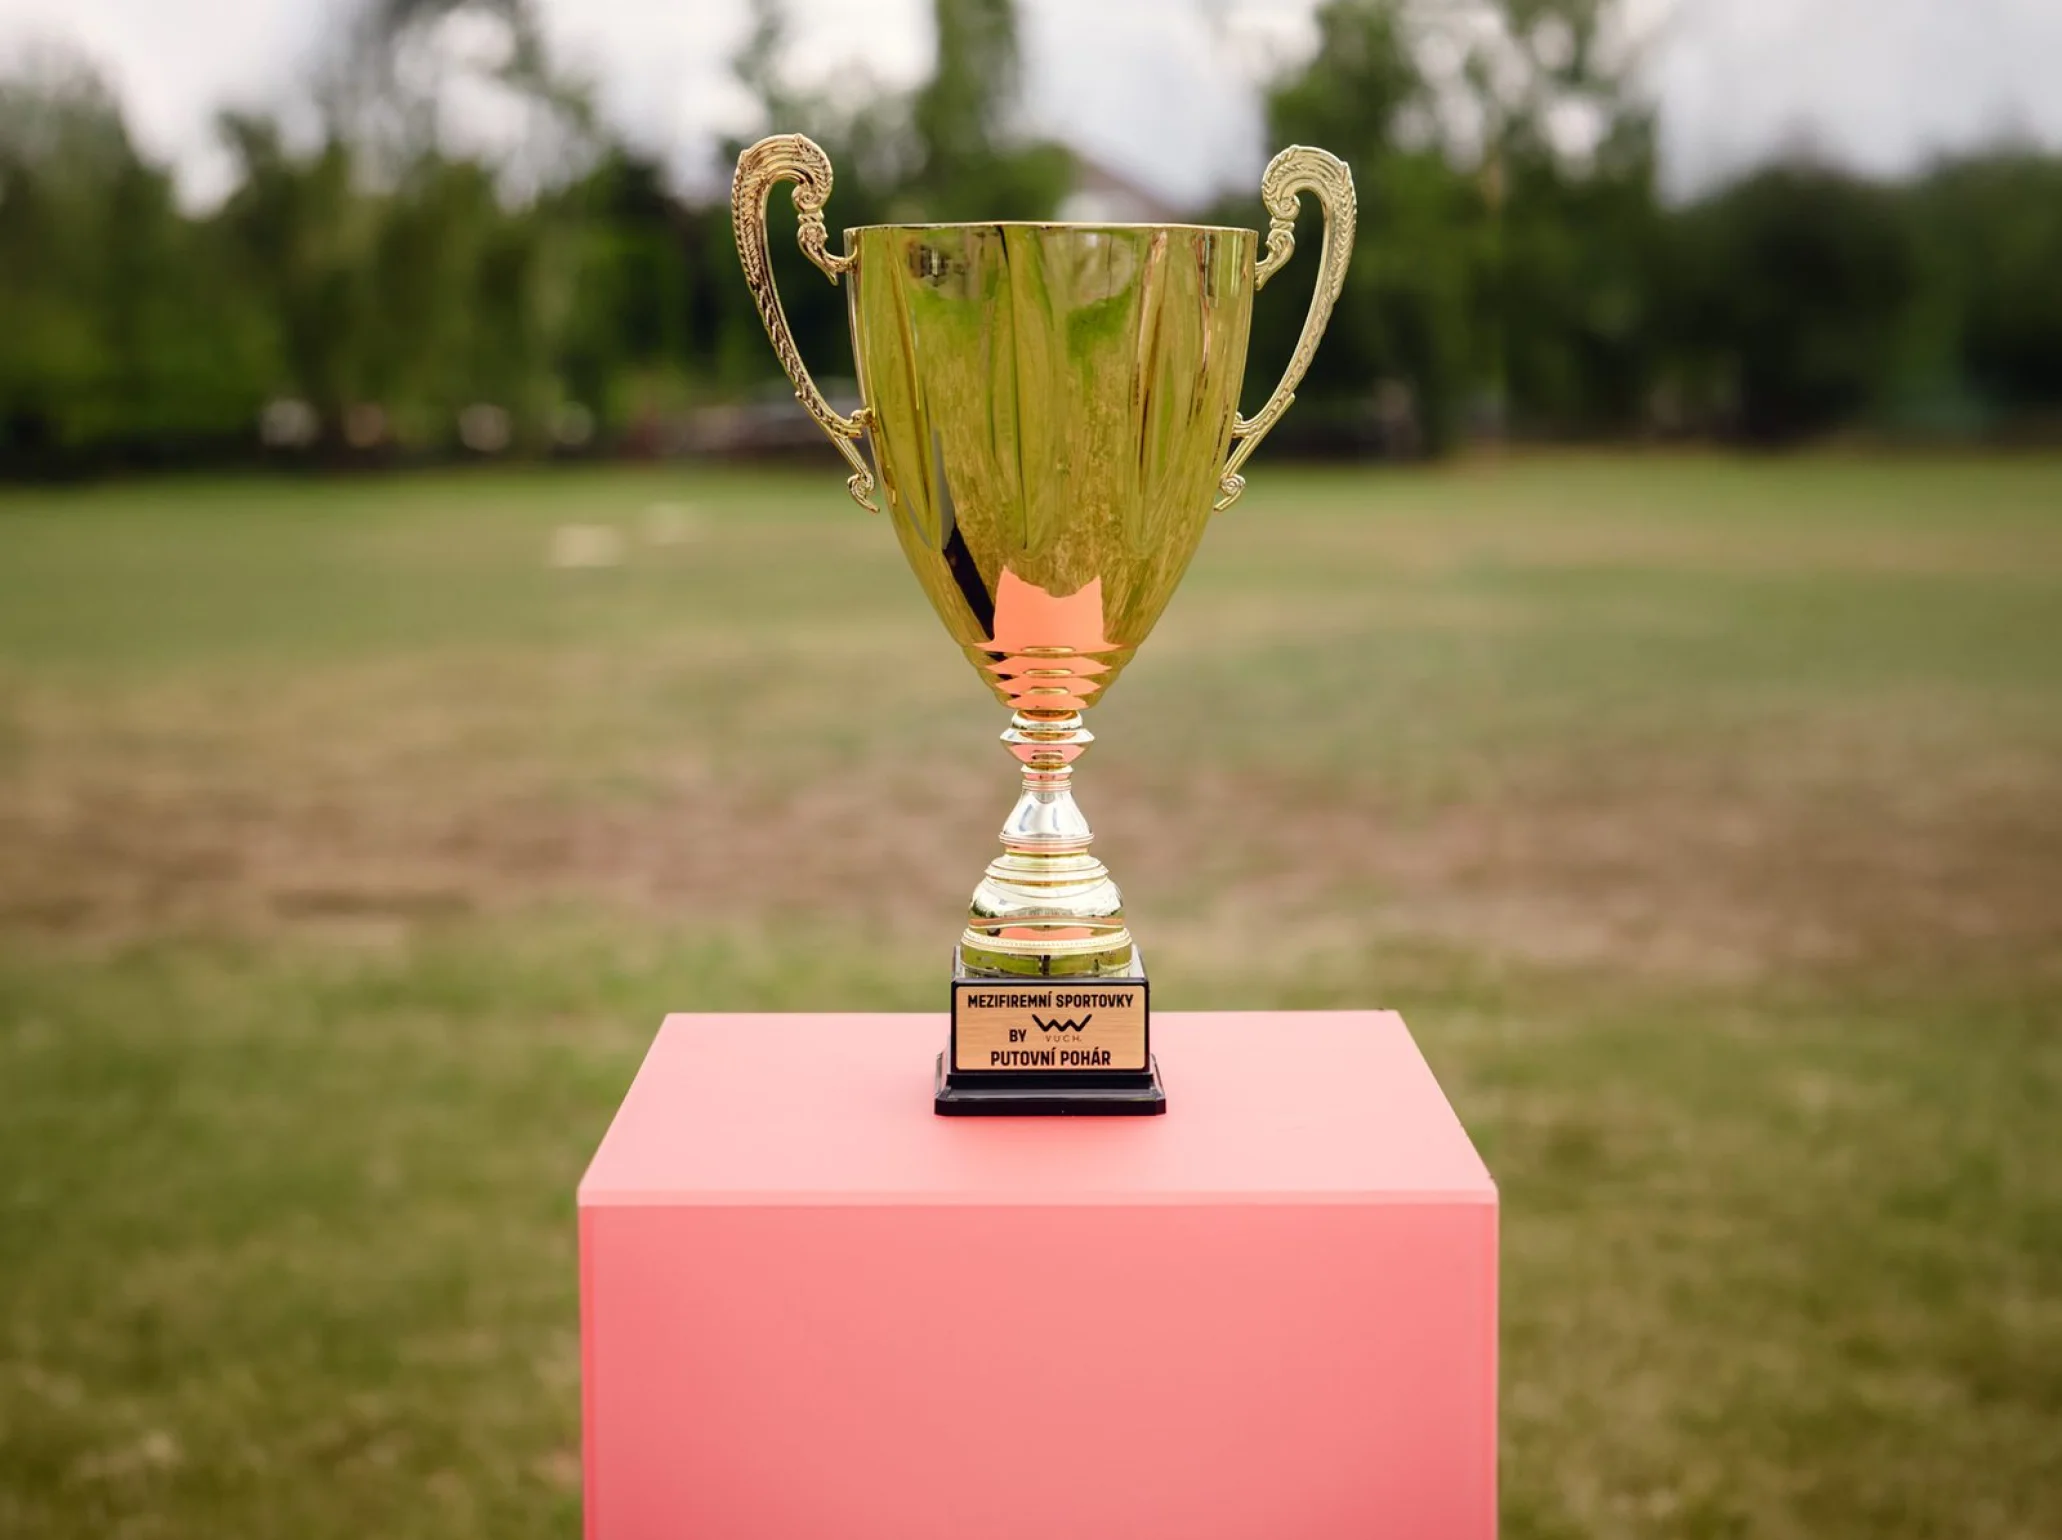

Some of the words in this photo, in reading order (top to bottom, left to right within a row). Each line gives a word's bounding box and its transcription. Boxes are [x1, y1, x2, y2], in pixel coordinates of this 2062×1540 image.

[967, 991, 1053, 1008] MEZIFIREMNÍ
[1056, 994, 1134, 1008] SPORTOVKY
[1009, 1029, 1027, 1042] BY
[990, 1047, 1056, 1066] PUTOVNÍ
[1060, 1047, 1111, 1066] POHÁR
